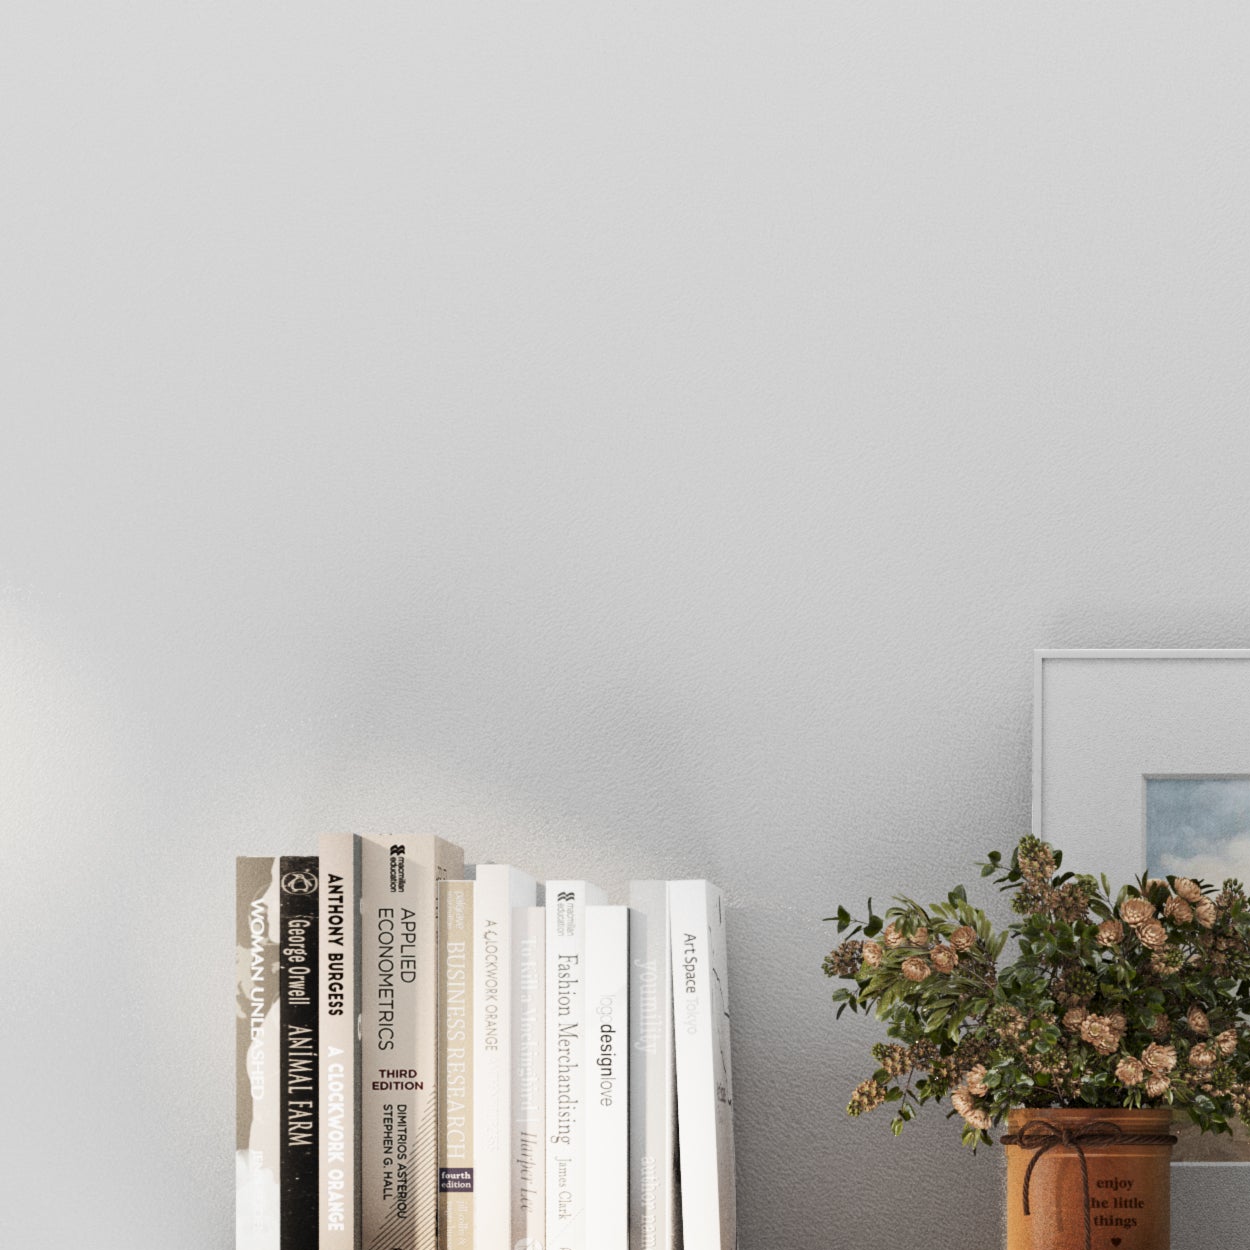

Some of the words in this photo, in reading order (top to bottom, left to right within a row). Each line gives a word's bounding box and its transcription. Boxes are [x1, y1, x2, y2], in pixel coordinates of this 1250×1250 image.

[390, 857, 398, 893] education
[327, 873, 344, 947] ANTHONY
[485, 919, 497, 927] A
[249, 898, 265, 980] WOMAN
[283, 918, 311, 963] George
[400, 908, 416, 984] APPLIED
[683, 933, 697, 955] Art
[288, 966, 311, 1005] Orwell
[327, 952, 344, 1016] BURGESS
[378, 908, 394, 1051] ECONOMETRICS
[482, 930, 498, 1001] CLOCKWORK
[558, 953, 578, 1017] Fashion
[682, 956, 698, 994] Space
[447, 942, 465, 1041] BUSINESS
[249, 984, 265, 1100] UNLEASHED
[484, 1003, 498, 1051] ORANGE
[327, 1046, 344, 1058] A
[379, 1069, 417, 1079] THIRD
[372, 1081, 424, 1091] EDITION
[447, 1048, 465, 1159] RESEARCH
[550, 1022, 578, 1145] Merchandising
[288, 1100, 313, 1147] FARM
[327, 1063, 344, 1163] CLOCKWORK
[383, 1104, 393, 1157] STEPHEN
[397, 1104, 407, 1159] DIMITRIOS
[383, 1159, 393, 1168] G.
[441, 1171, 471, 1179] fourth
[516, 1131, 538, 1185] Harper
[554, 1155, 573, 1188] James
[327, 1171, 344, 1232] ORANGE
[383, 1172, 393, 1201] HALL
[397, 1161, 407, 1219] ASTERIOU
[441, 1181, 472, 1189] edition
[520, 1187, 537, 1214] Lee
[640, 1155, 660, 1209] author
[1096, 1176, 1135, 1191] enjoy
[1113, 1196, 1145, 1209] little
[558, 1190, 573, 1222] Clark
[1093, 1214, 1137, 1230] things
